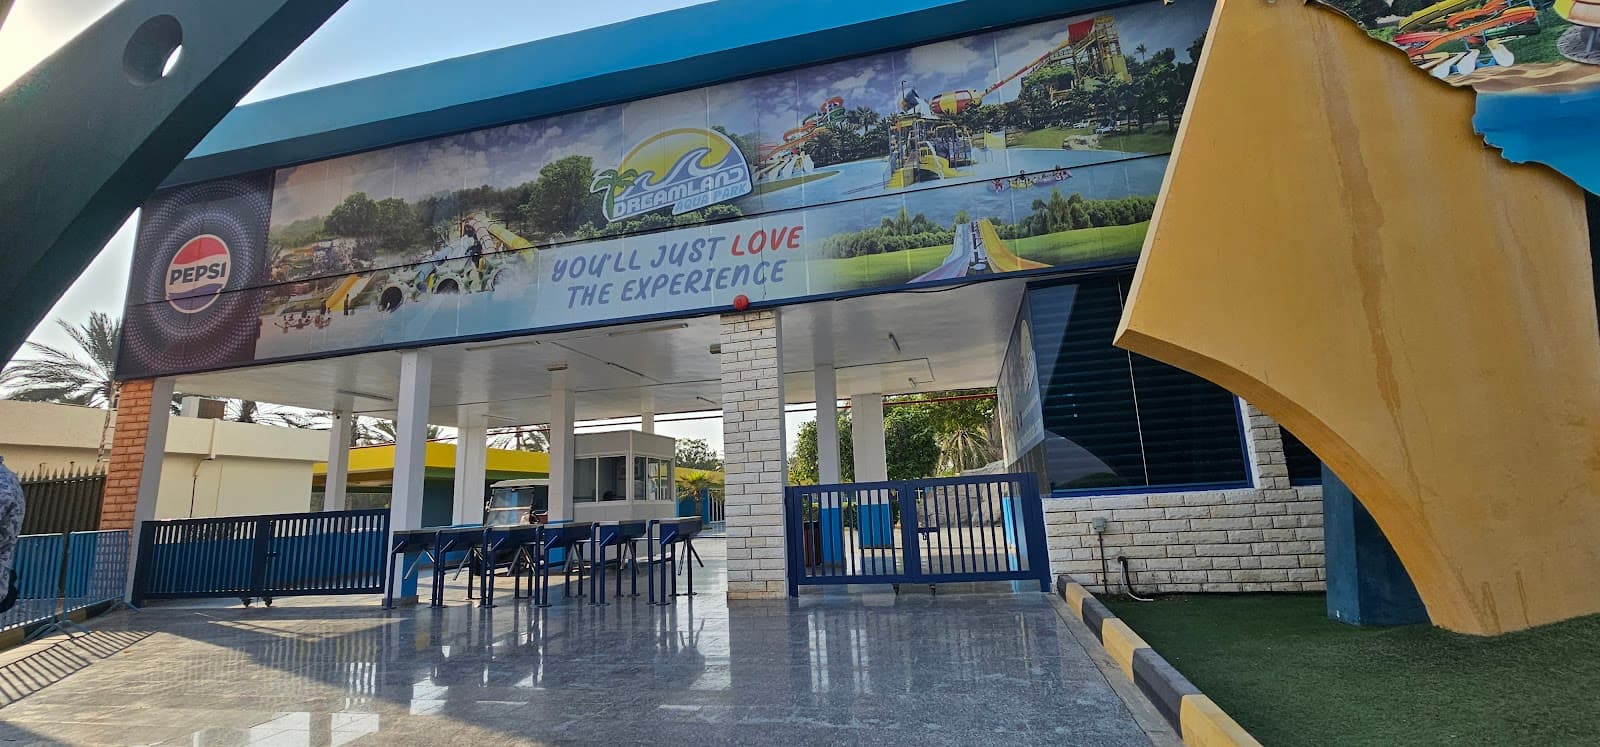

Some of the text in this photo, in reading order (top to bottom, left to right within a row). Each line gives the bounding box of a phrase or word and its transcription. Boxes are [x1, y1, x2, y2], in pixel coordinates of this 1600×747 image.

[613, 168, 744, 217] DREAMLAND
[675, 184, 748, 213] AQUA PARK
[169, 262, 227, 285] PEPSI
[552, 226, 804, 282] YOU'LL JUST LOVE
[567, 259, 788, 309] THE EXPERIENCE
